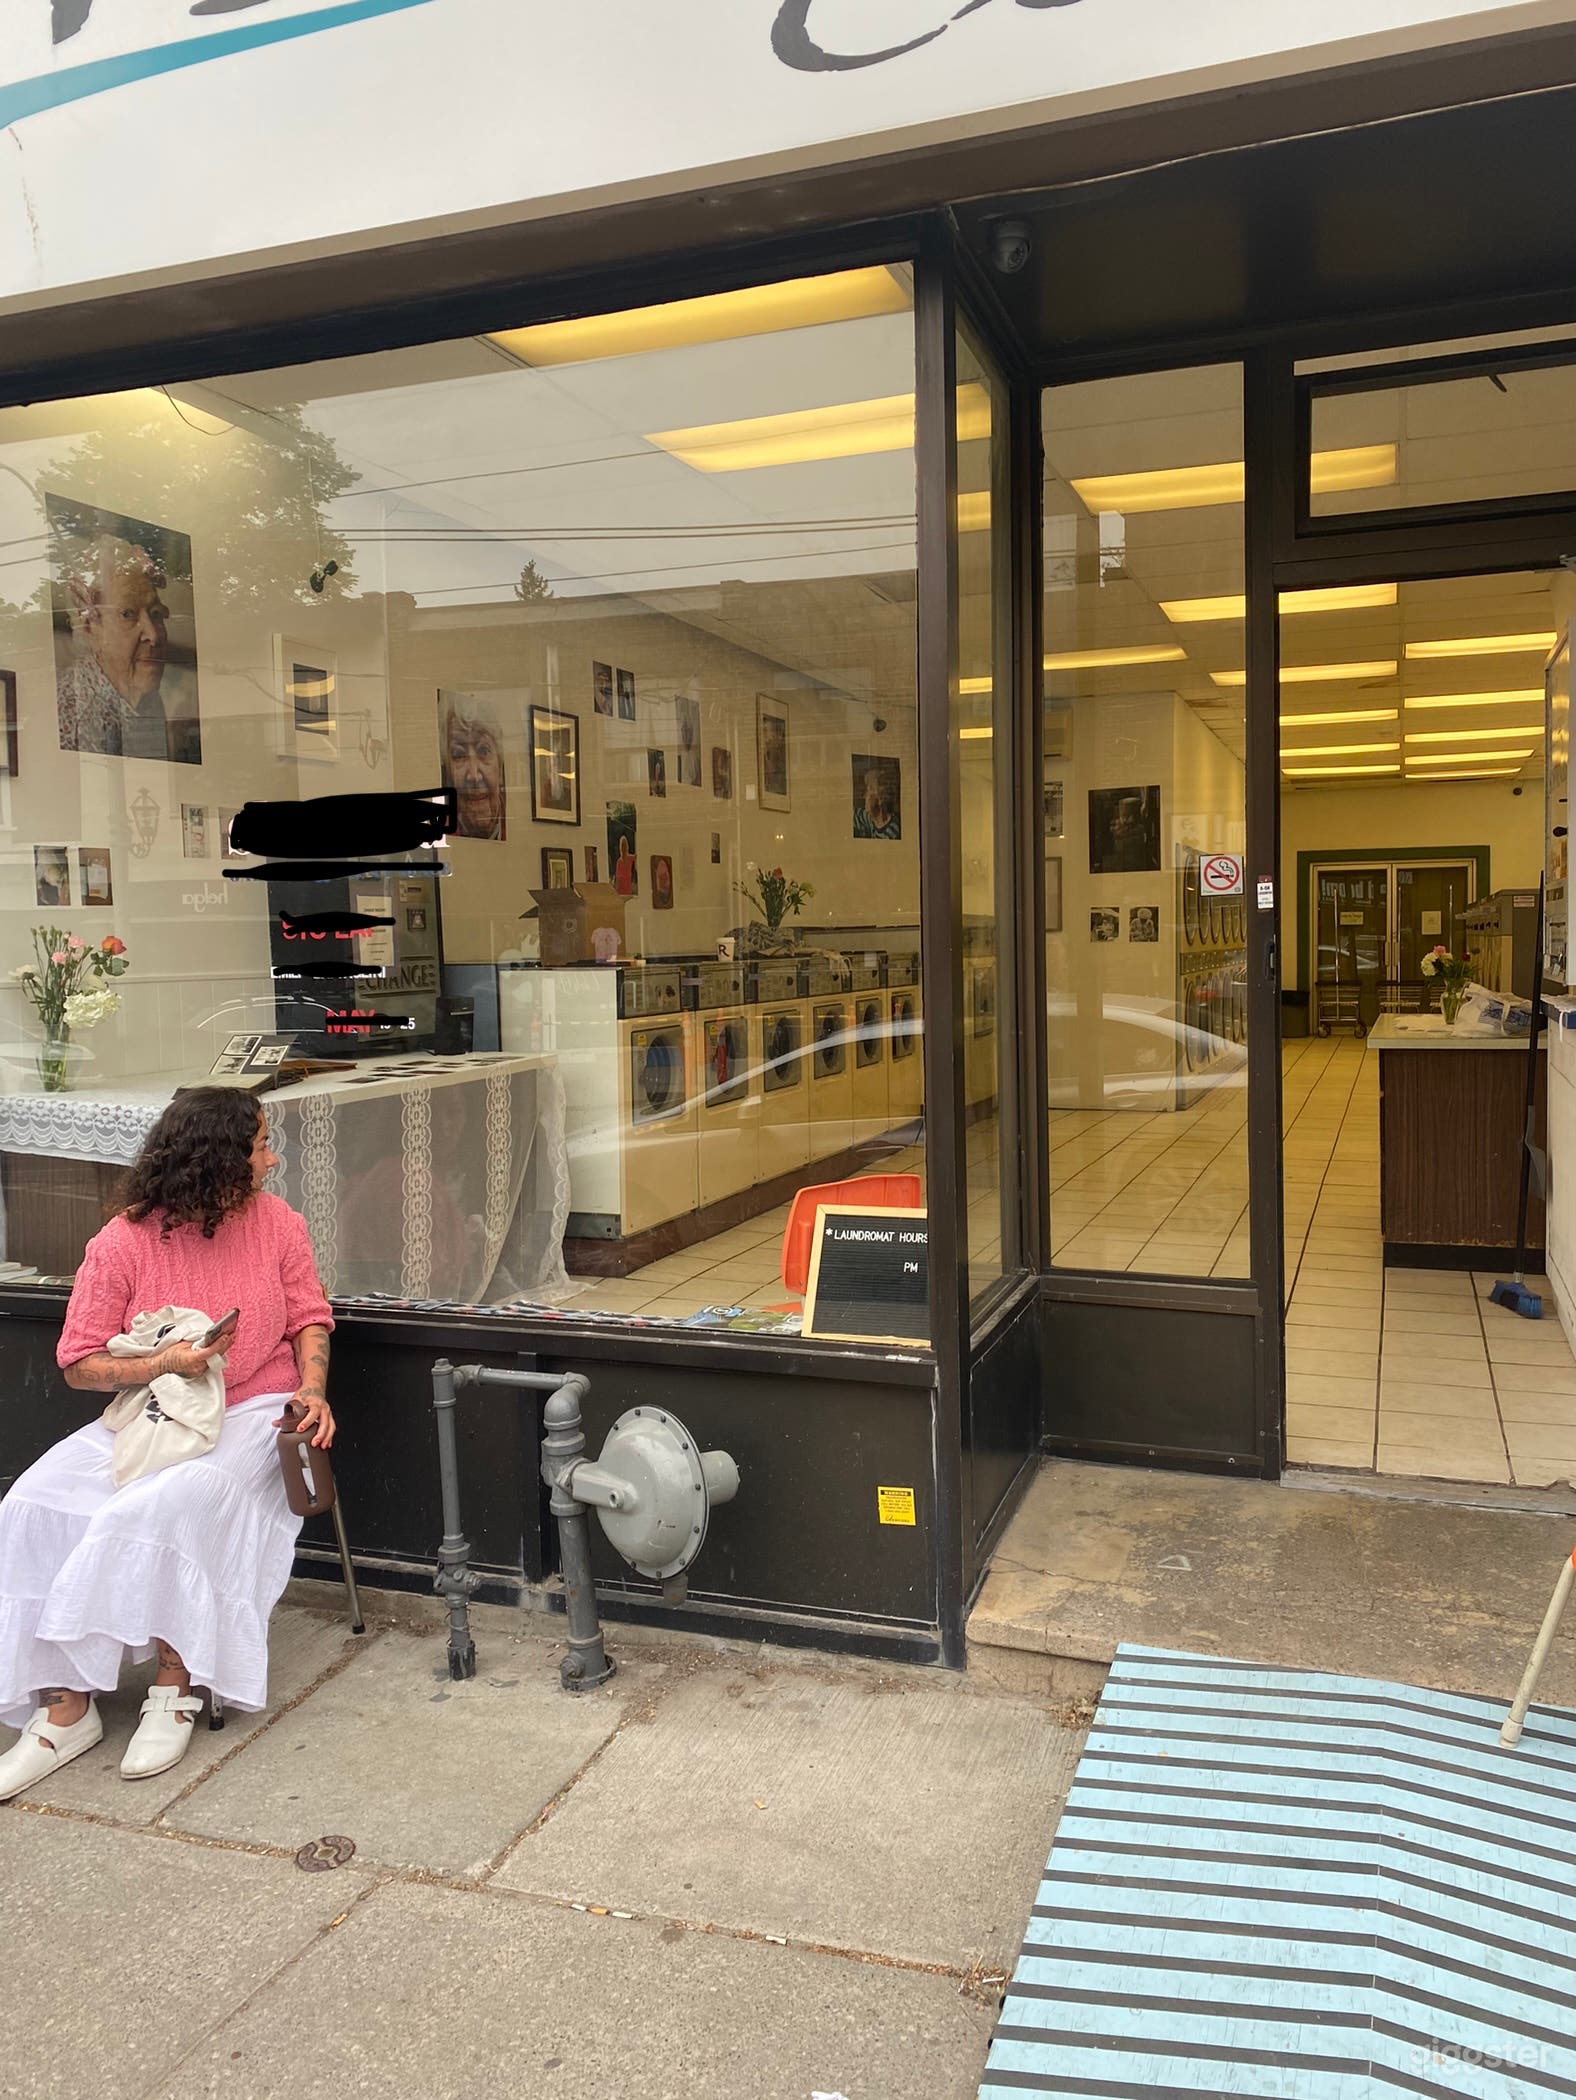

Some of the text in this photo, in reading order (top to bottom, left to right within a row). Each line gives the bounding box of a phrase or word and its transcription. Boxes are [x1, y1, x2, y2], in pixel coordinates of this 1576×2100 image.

[719, 944, 729, 957] R
[366, 963, 429, 991] CHANGE
[903, 1261, 918, 1273] PM
